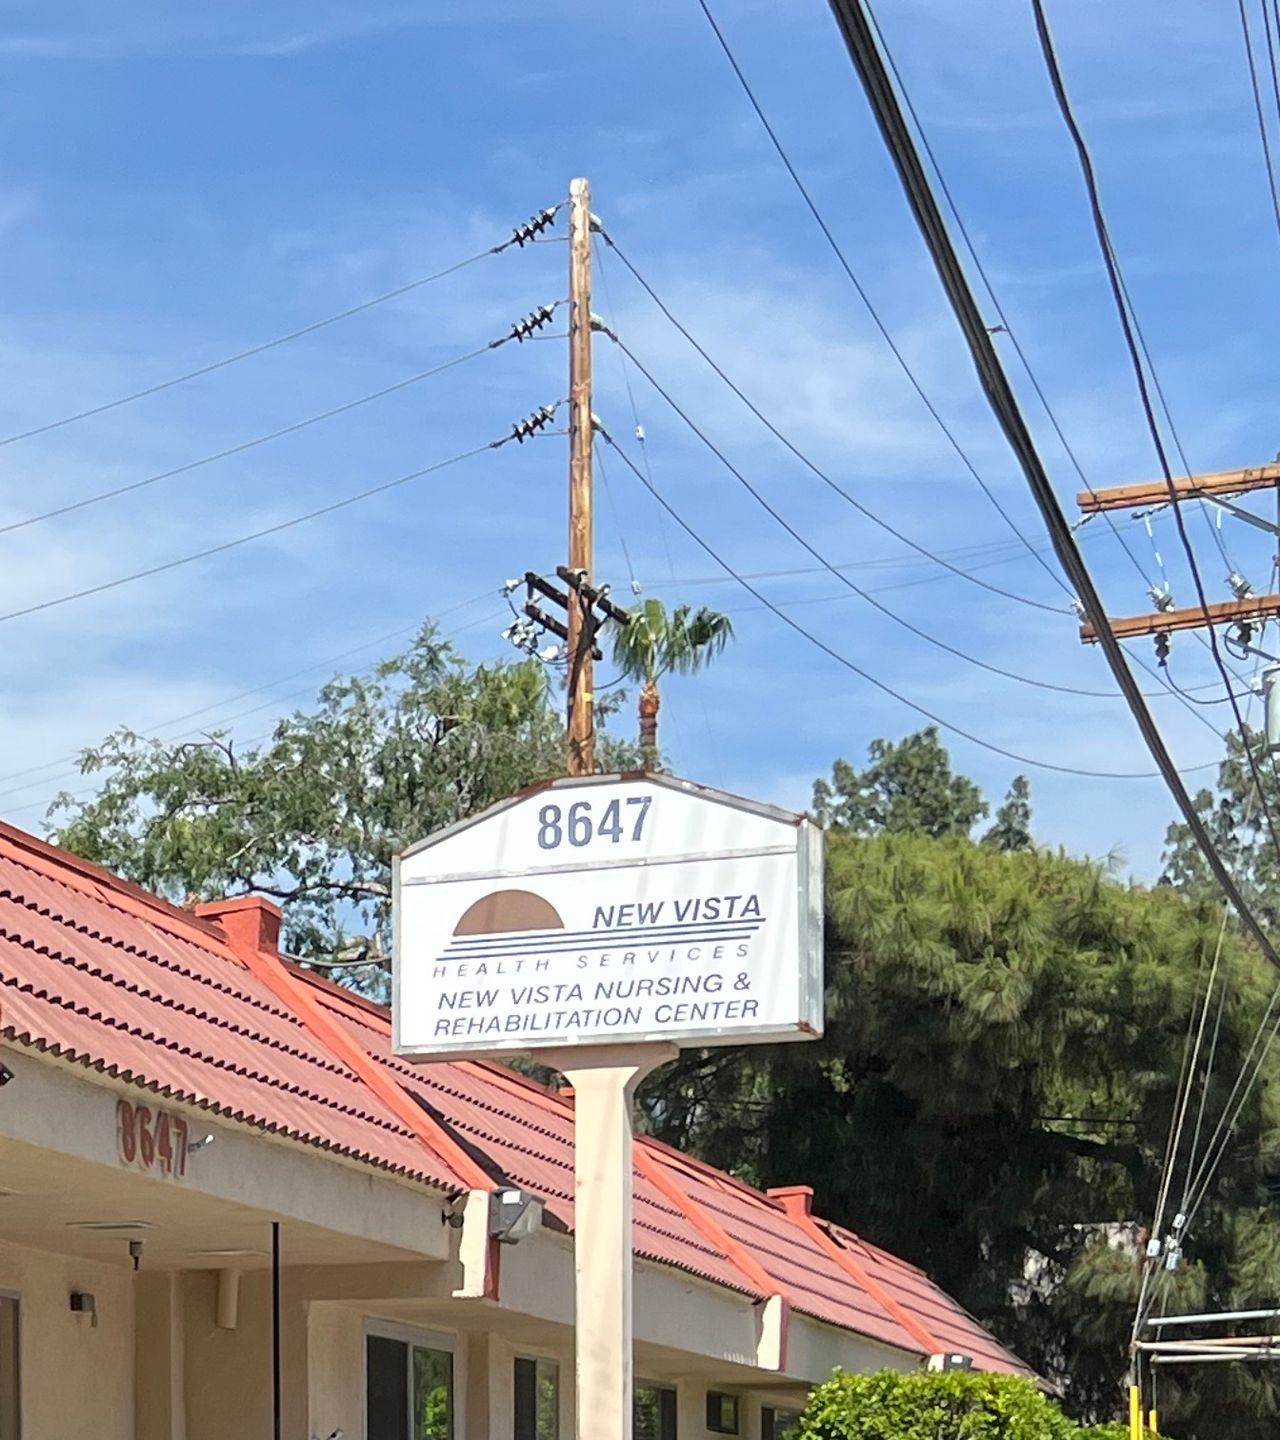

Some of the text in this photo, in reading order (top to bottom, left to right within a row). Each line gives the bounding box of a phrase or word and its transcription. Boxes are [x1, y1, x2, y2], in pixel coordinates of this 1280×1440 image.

[537, 796, 653, 850] 8647
[592, 894, 761, 929] NEW VISTA
[433, 943, 749, 979] HEALTH SERVICES
[438, 972, 752, 1011] NEW VISTA NURSING &
[433, 999, 759, 1037] REHABILITATION CENTER
[116, 1099, 188, 1177] 8647
